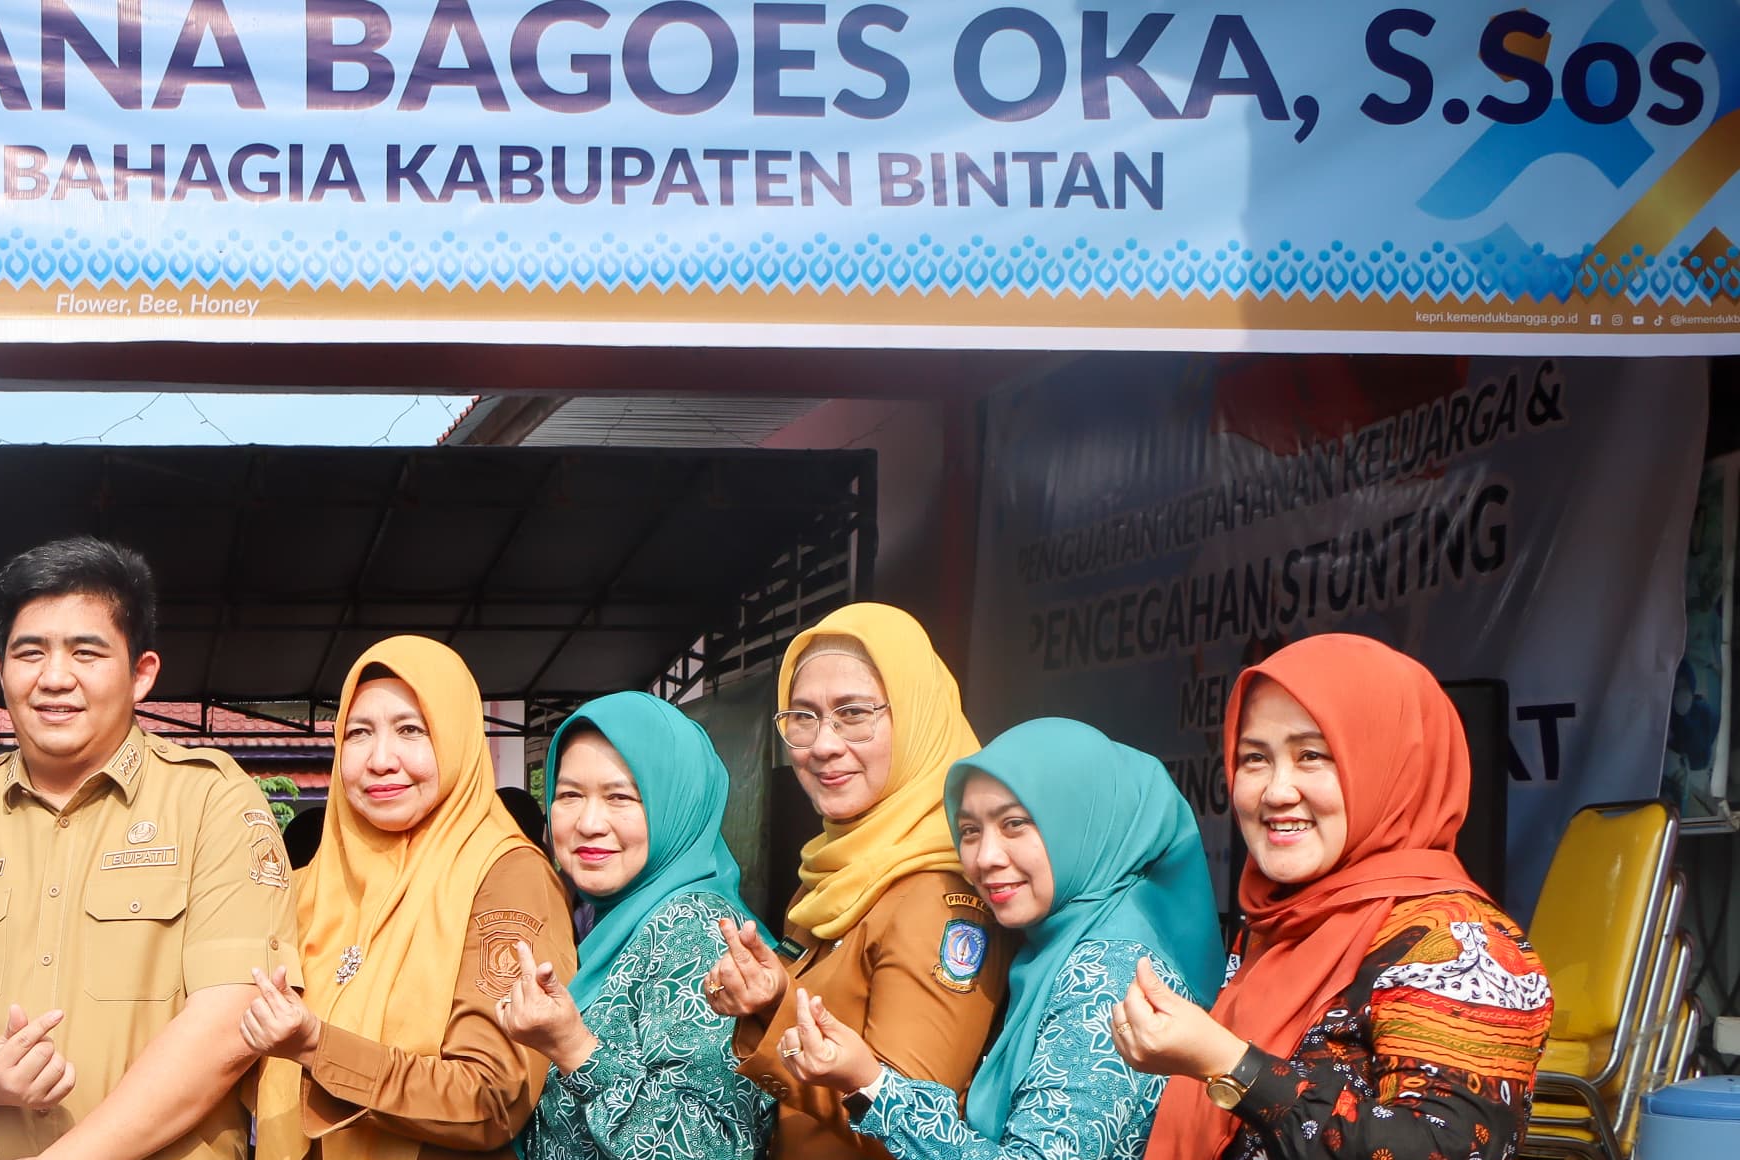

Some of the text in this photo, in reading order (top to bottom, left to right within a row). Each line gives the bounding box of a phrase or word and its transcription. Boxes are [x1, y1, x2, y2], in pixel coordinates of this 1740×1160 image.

[305, 0, 911, 119] BAGOES
[952, 4, 1320, 145] OKA,
[1359, 7, 1707, 126] S.Sos
[3, 143, 366, 203] BAHAGIA
[386, 144, 852, 207] KABUPATEN
[878, 151, 1164, 211] BINTAN
[56, 294, 260, 317] Flower, Bee, Honey
[1415, 311, 1579, 326] kepri.kemendukbangga.go.id
[1018, 359, 1565, 583] PENGUATAN KETAHANAN KELUARGA &
[1278, 484, 1510, 625] STUNTING
[112, 849, 167, 865] BUPATI
[483, 912, 509, 924] PROV.
